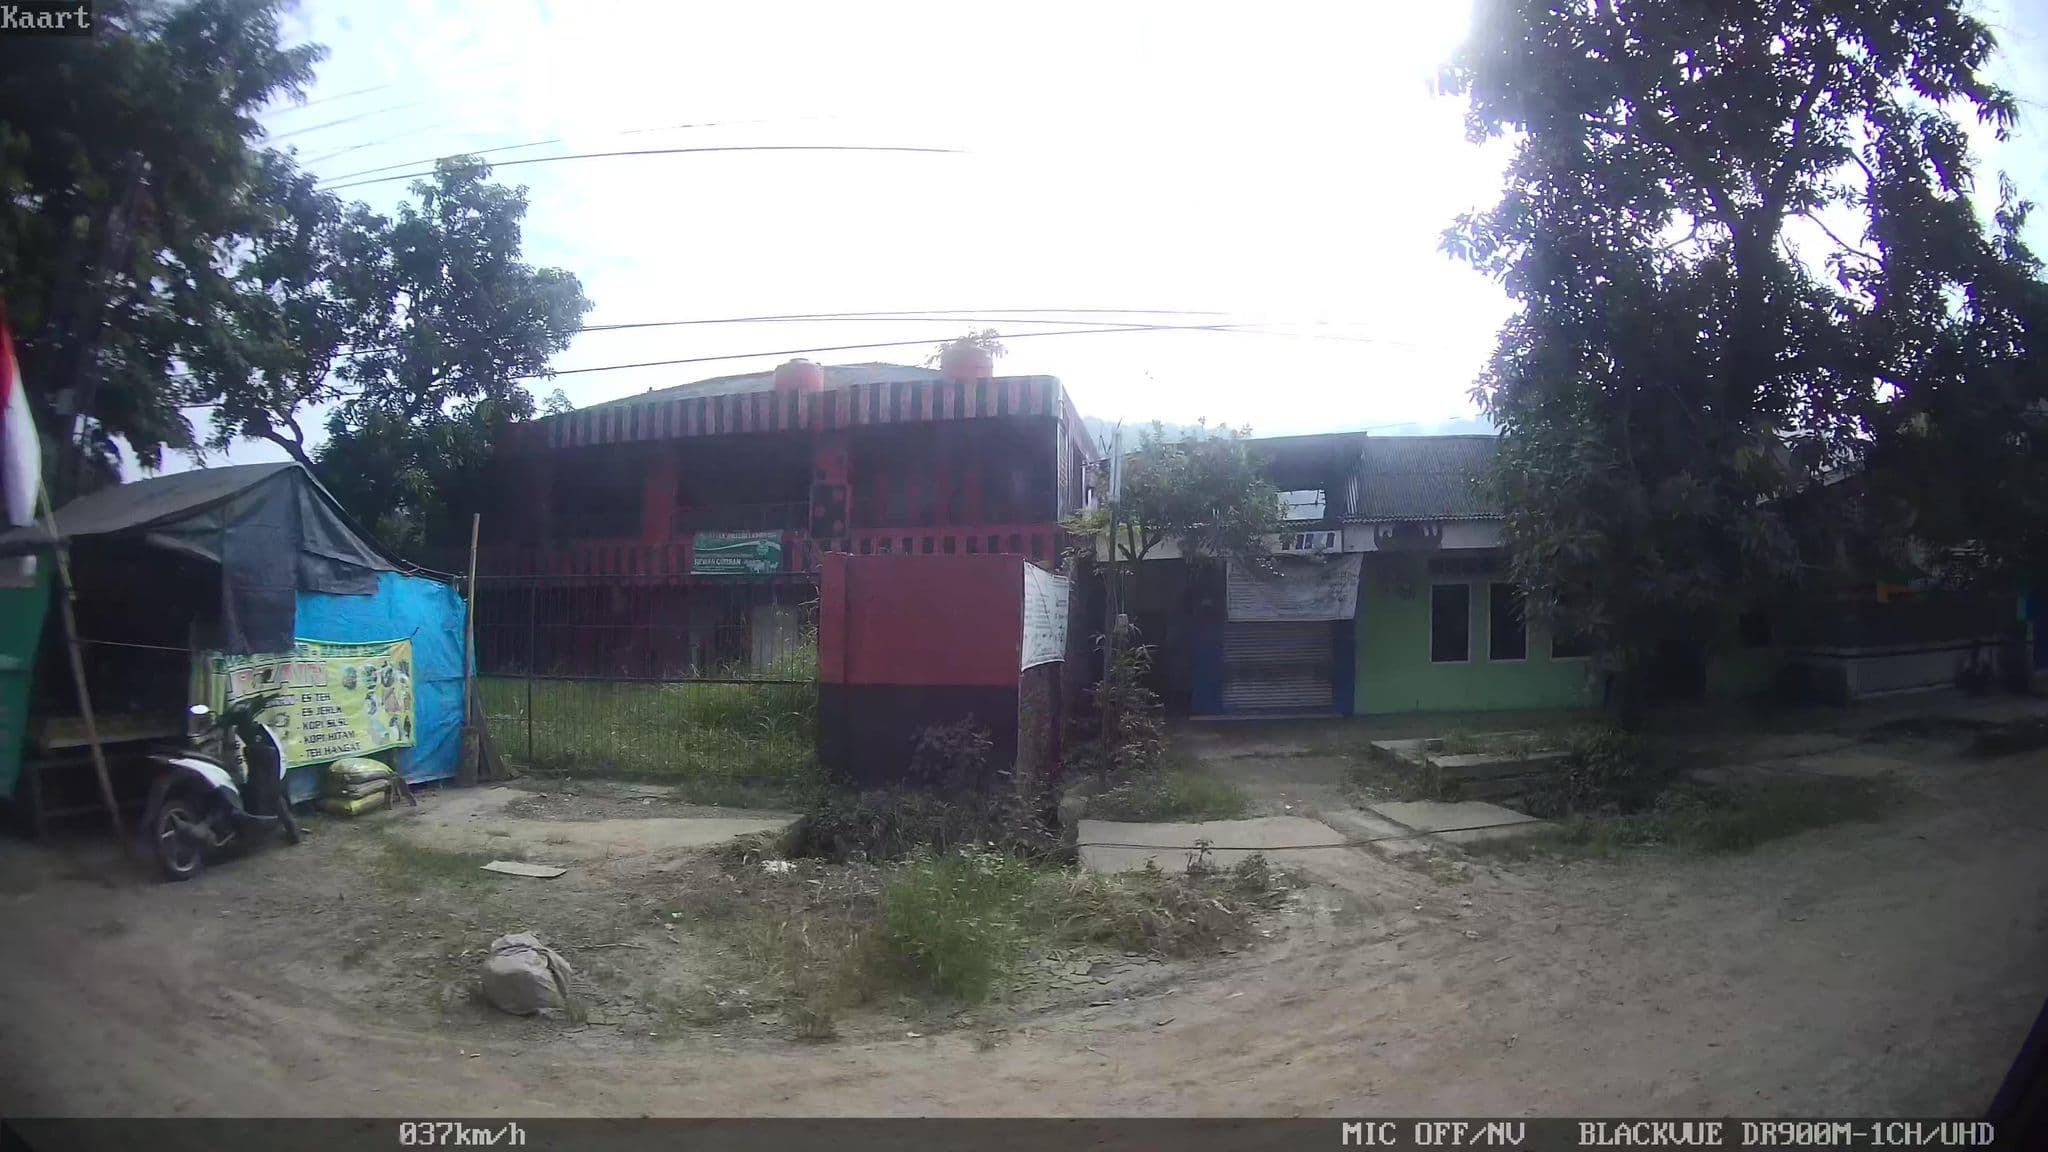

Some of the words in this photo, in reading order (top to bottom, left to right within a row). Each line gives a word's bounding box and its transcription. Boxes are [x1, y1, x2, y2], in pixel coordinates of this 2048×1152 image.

[302, 720, 324, 731] KOPI
[304, 733, 325, 744] KOPI
[328, 730, 356, 741] HITAM
[305, 747, 322, 758] TEH
[324, 741, 361, 756] HANGAT
